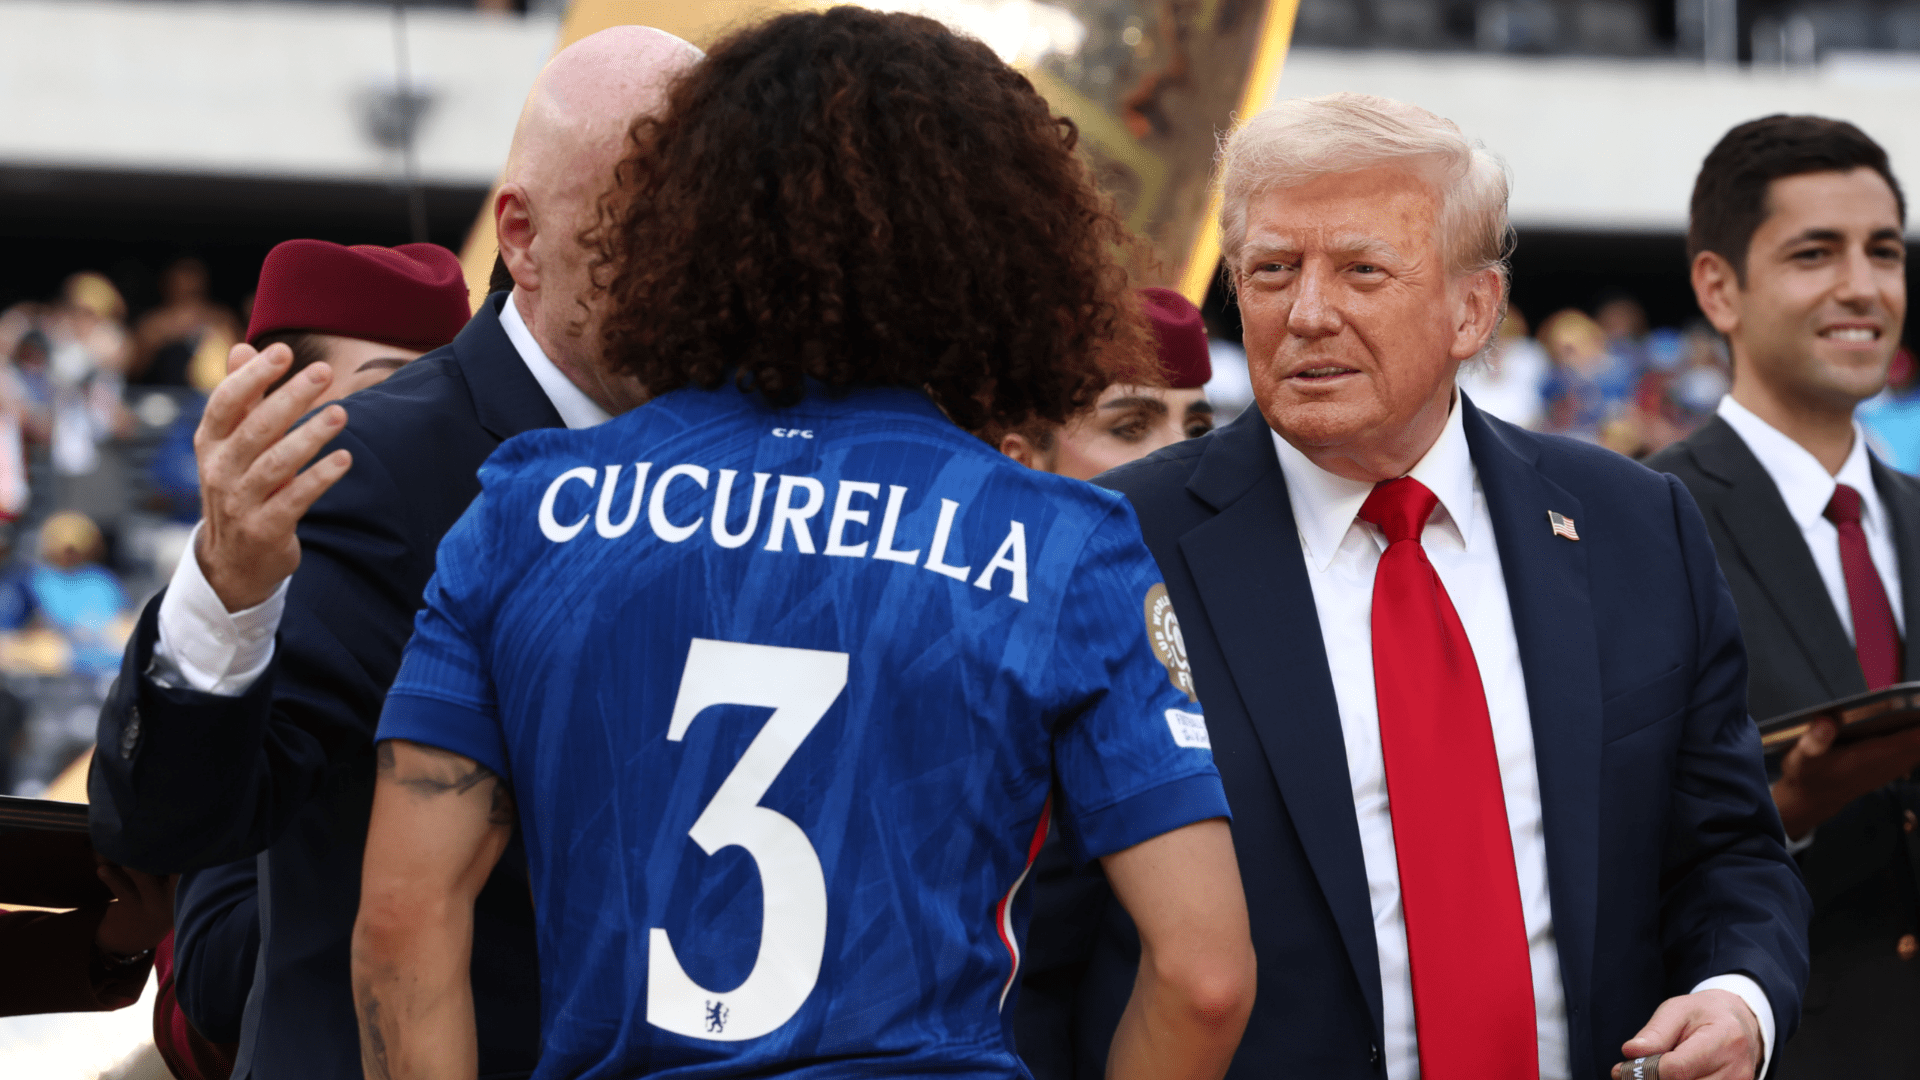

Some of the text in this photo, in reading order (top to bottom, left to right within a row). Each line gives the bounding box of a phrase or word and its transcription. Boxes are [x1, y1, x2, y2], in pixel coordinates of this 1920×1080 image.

[771, 427, 814, 439] CFC
[538, 461, 1029, 603] CUCURELLA
[646, 637, 850, 1042] 3
